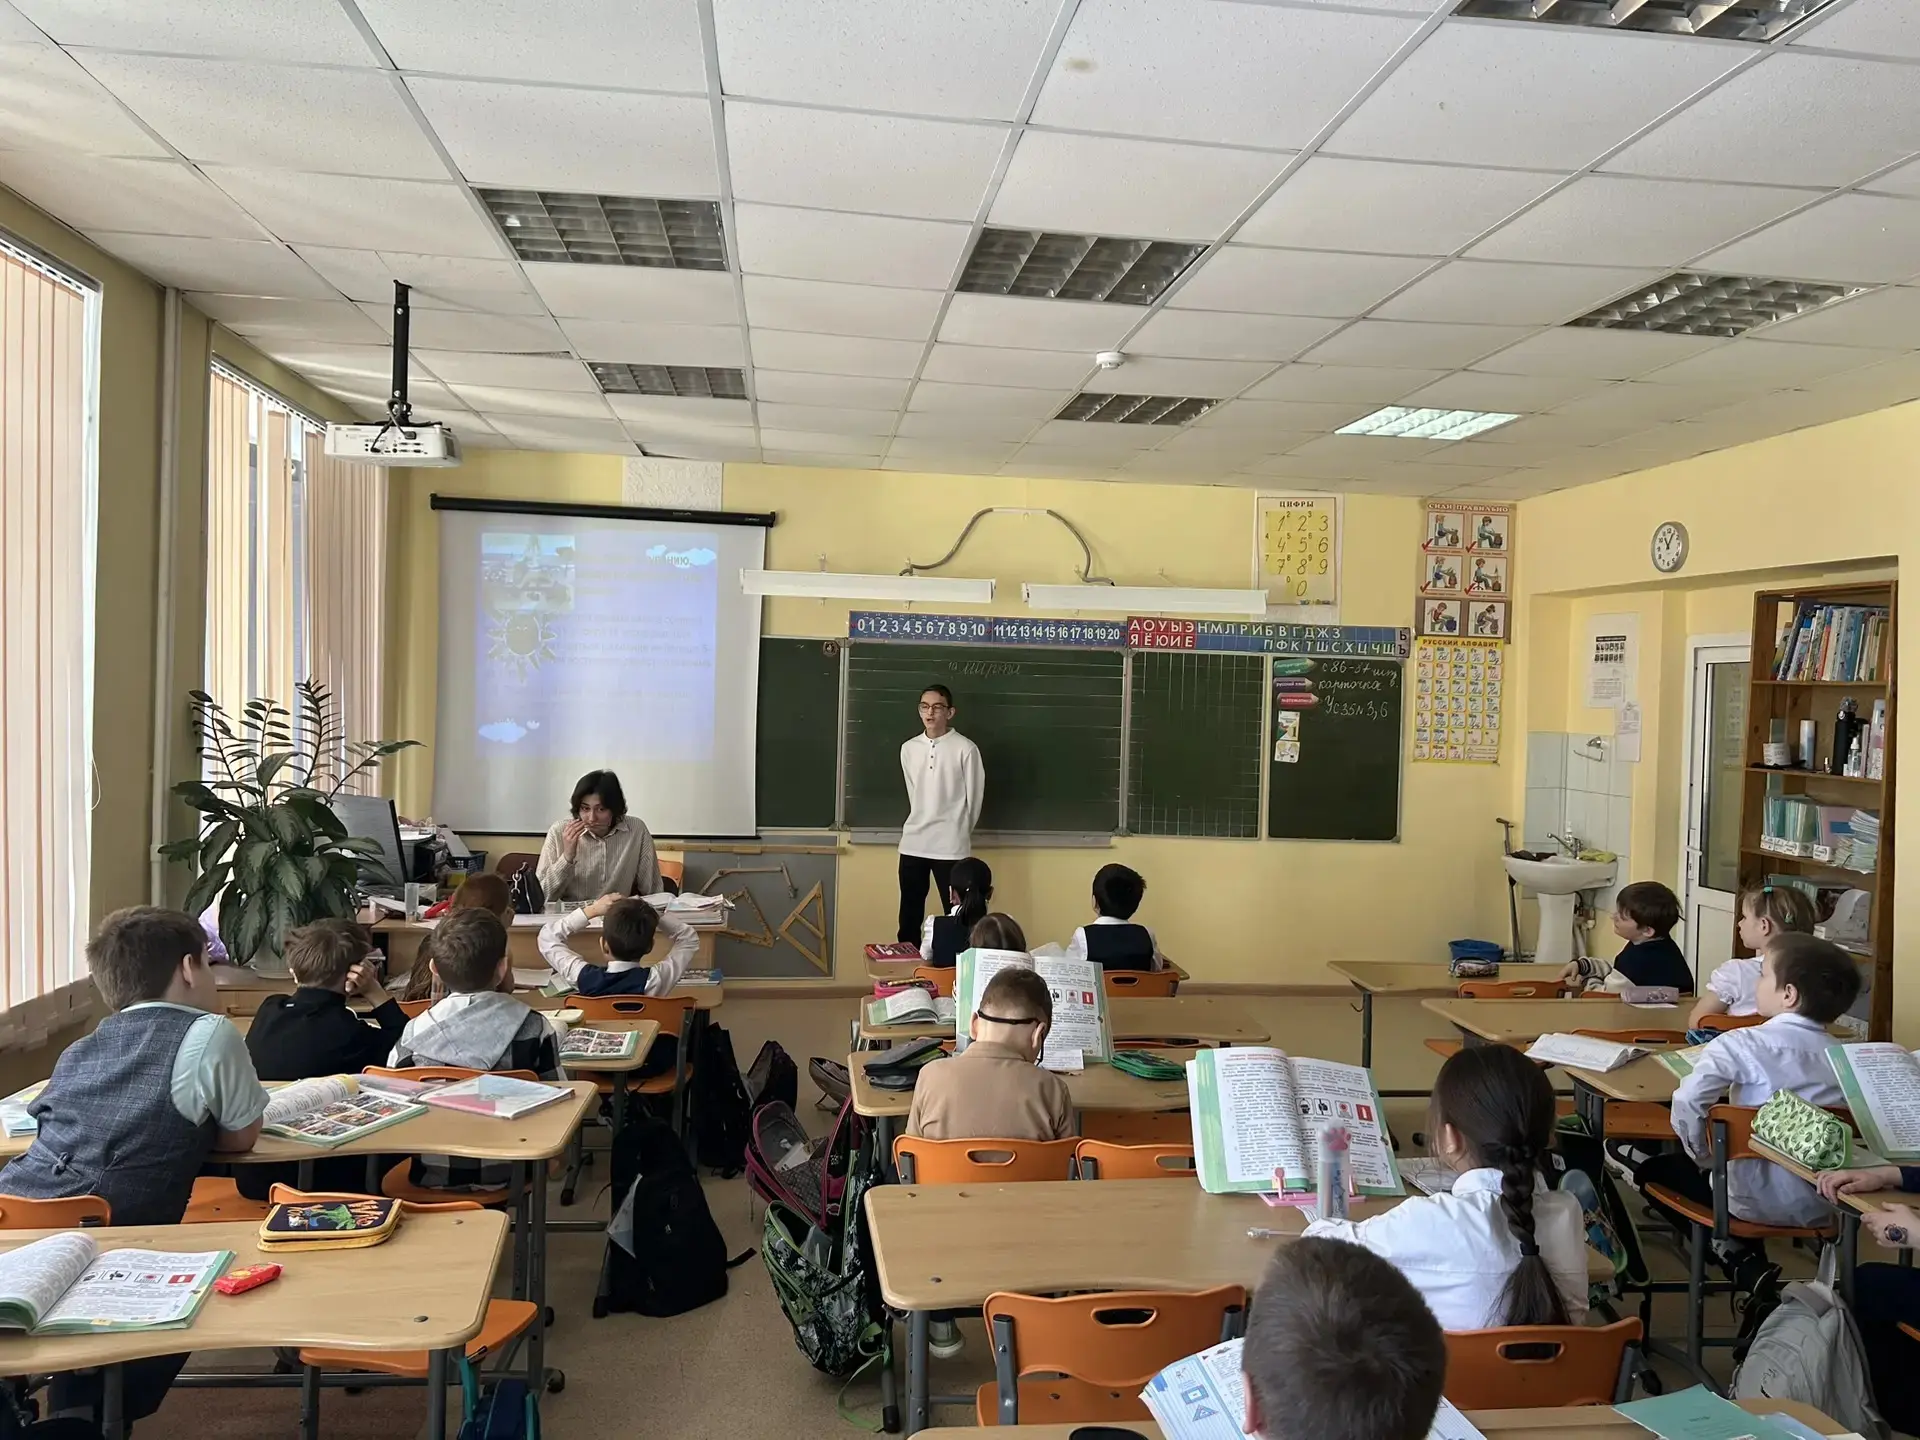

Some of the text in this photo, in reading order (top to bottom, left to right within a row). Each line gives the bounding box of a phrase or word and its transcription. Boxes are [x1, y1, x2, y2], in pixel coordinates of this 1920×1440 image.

[1278, 515, 1328, 531] 1 2 3
[1278, 537, 1328, 553] 4 5 6
[1277, 559, 1328, 575] 7 8 9
[1297, 580, 1307, 596] 0
[858, 619, 985, 636] 0 1 2 3 4 5 6 7 8 9 10
[994, 625, 1120, 640] 11 12 13 14 15 16 17 18 19 20
[1130, 620, 1406, 640] А О У Ы Э Н М Л Р Й Б В Г Д Ж З Ь
[1130, 633, 1406, 655] Я Ё Ю И Е П Ф К Т Ш С Х Ц Ч Щ Ъ
